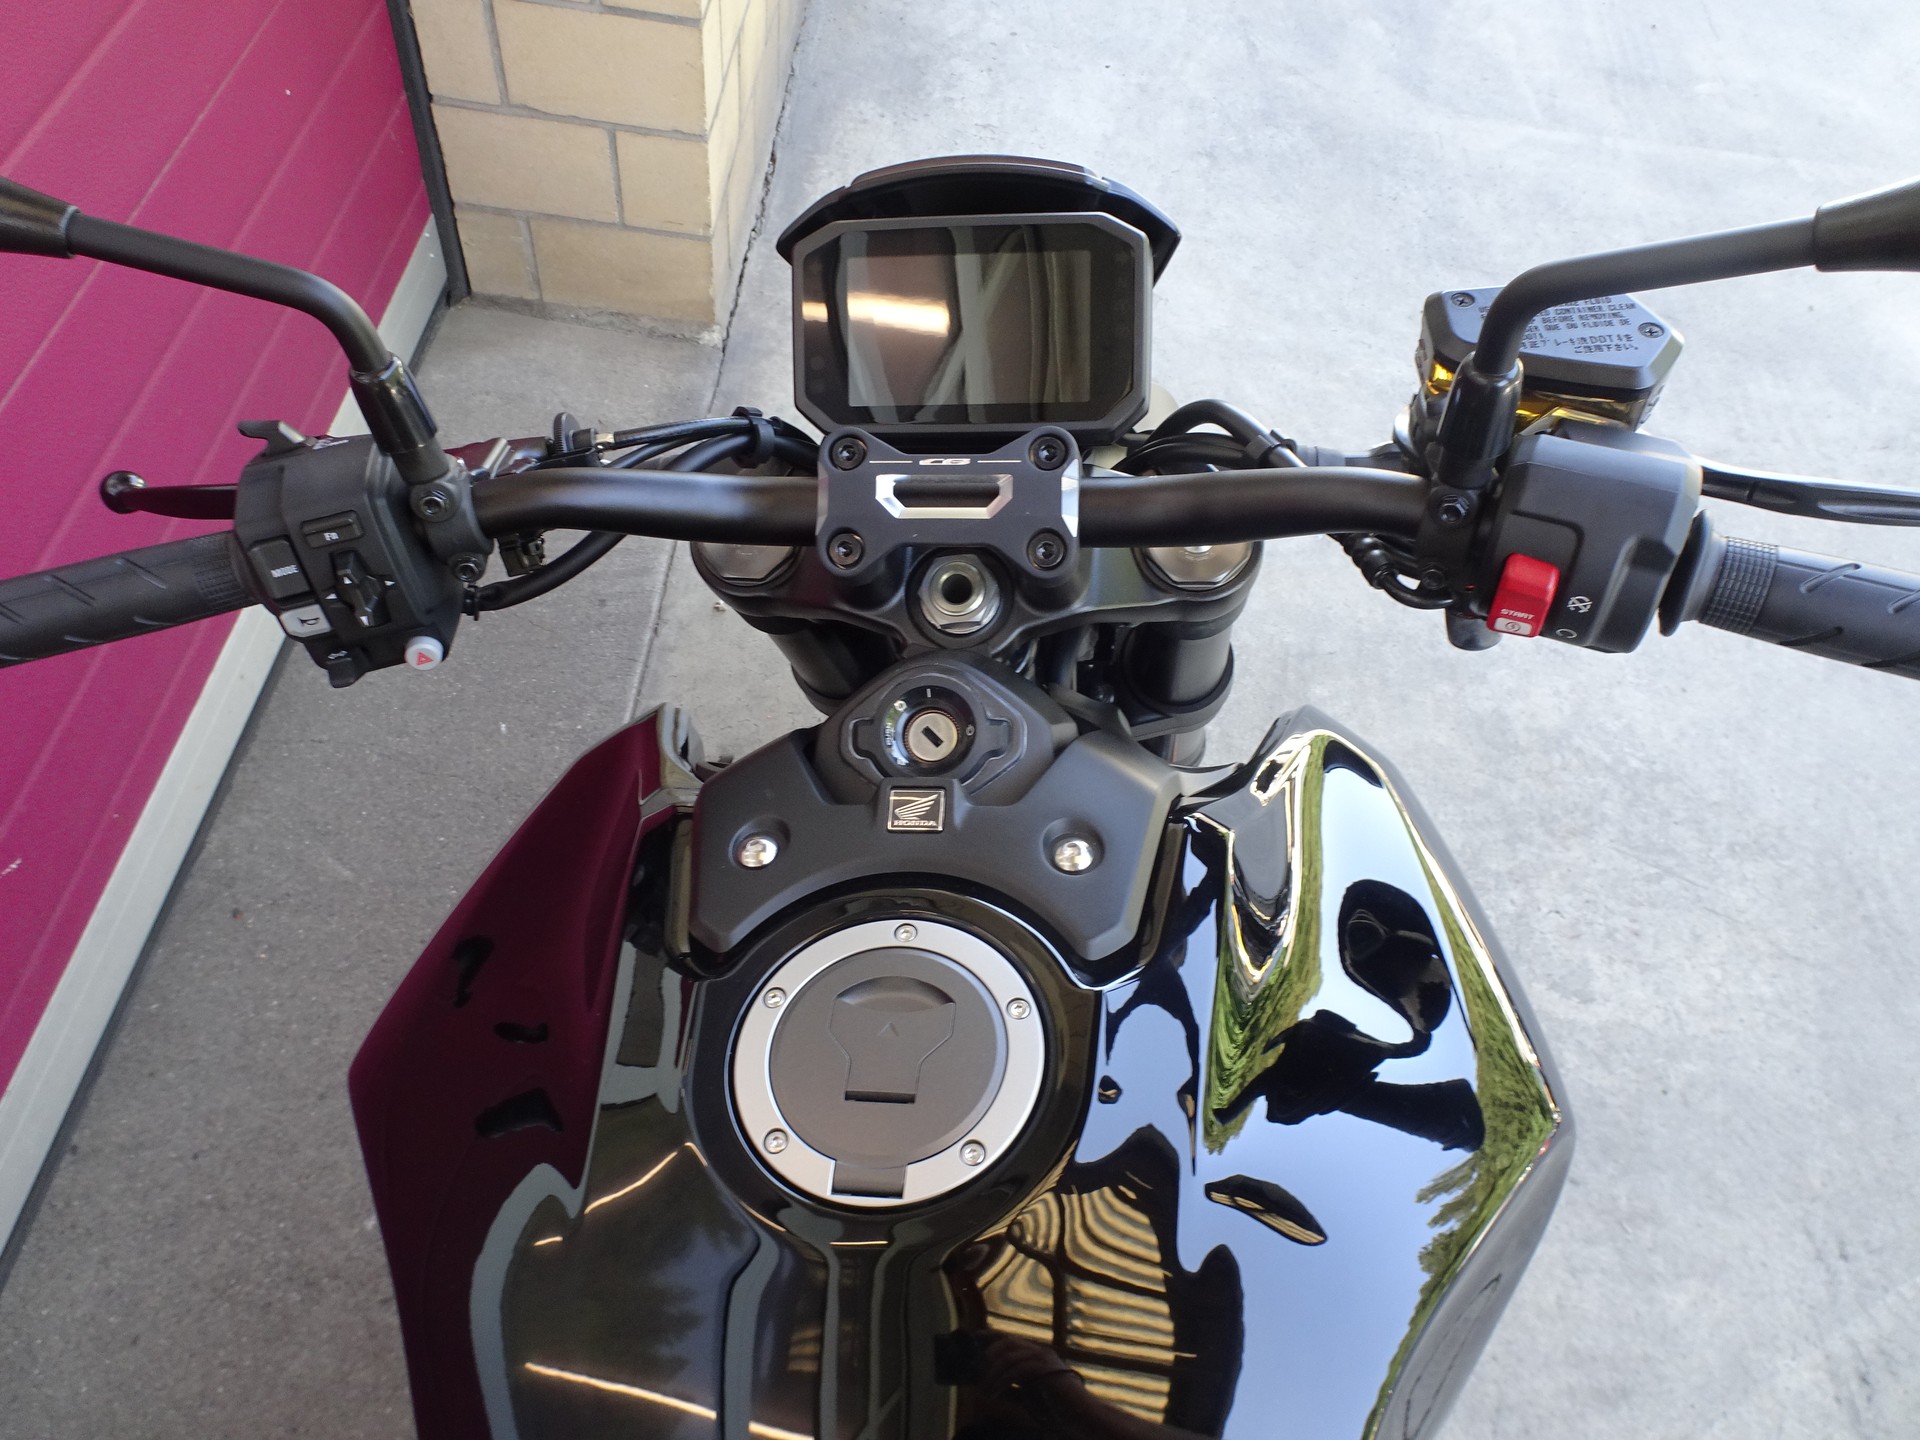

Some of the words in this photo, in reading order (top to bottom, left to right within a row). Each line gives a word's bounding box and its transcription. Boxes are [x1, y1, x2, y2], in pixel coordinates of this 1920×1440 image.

[1542, 315, 1575, 324] BEFORE
[271, 565, 299, 578] MODE
[1500, 609, 1535, 620] START
